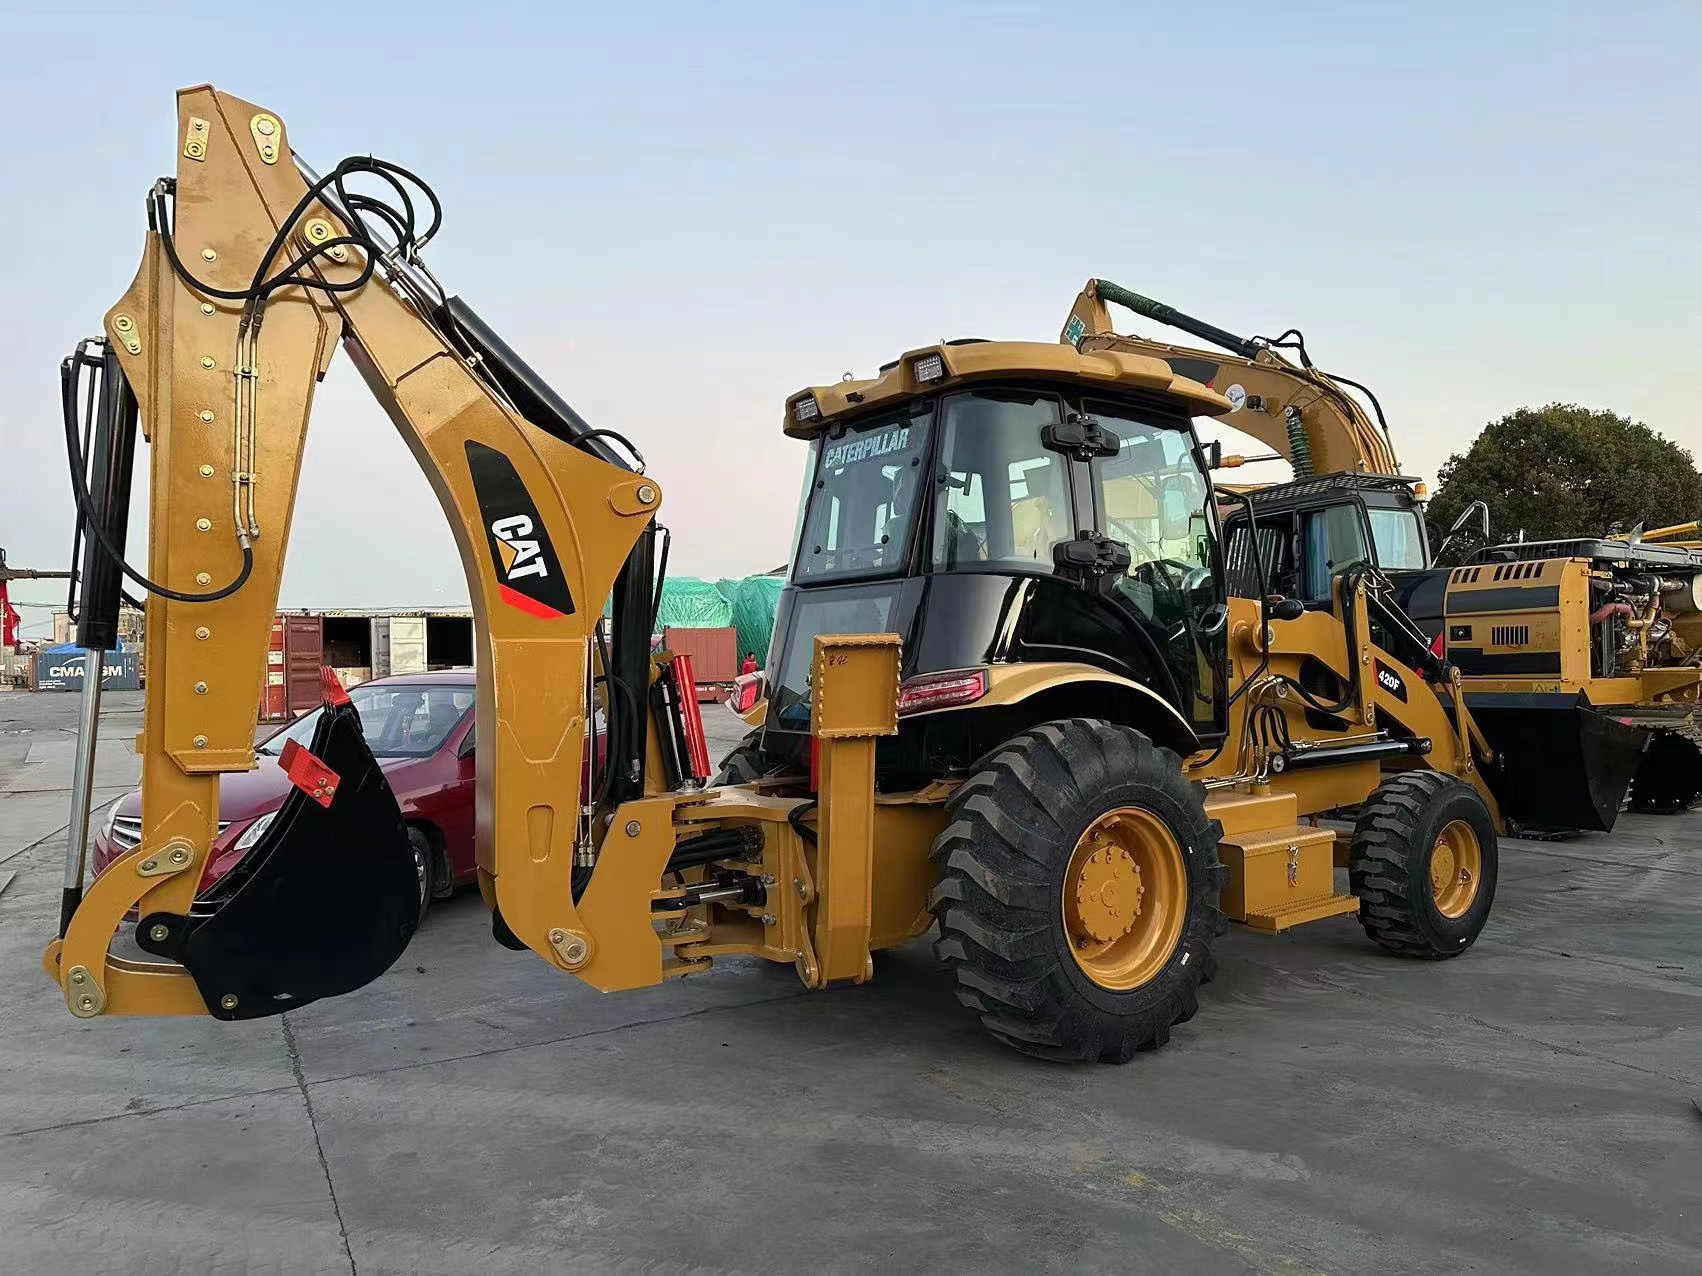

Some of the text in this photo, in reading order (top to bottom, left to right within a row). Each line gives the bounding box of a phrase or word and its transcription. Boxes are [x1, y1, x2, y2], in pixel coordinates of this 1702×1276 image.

[824, 428, 909, 469] CATERPILLAR
[491, 514, 548, 580] CAT
[49, 666, 85, 677] CMA
[1378, 670, 1400, 690] 420F
